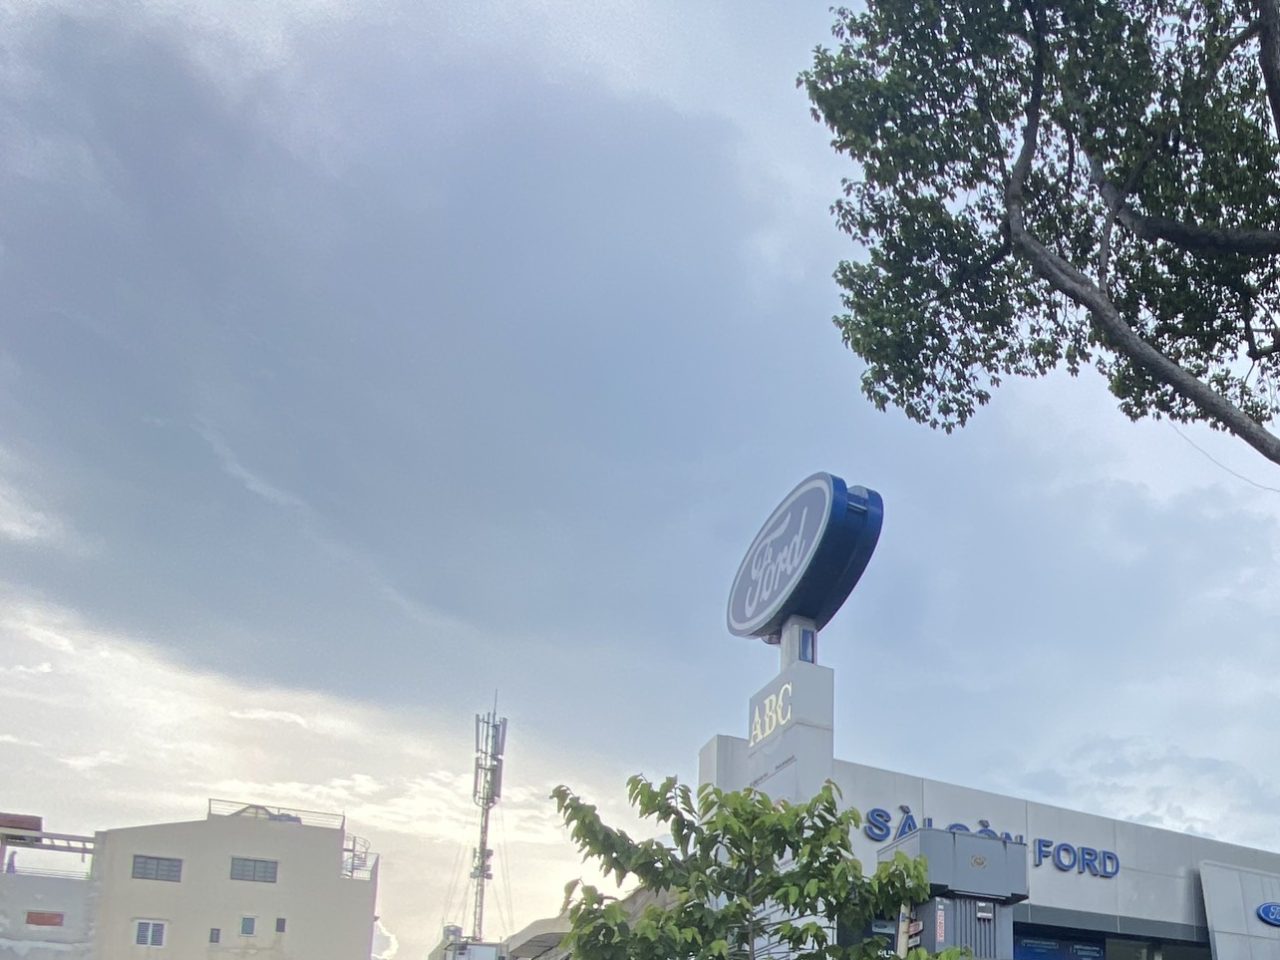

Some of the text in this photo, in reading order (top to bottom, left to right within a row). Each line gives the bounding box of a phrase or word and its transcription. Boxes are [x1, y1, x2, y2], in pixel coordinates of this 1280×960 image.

[745, 506, 809, 618] Ford
[748, 681, 793, 748] ABC
[1033, 838, 1121, 879] FORD
